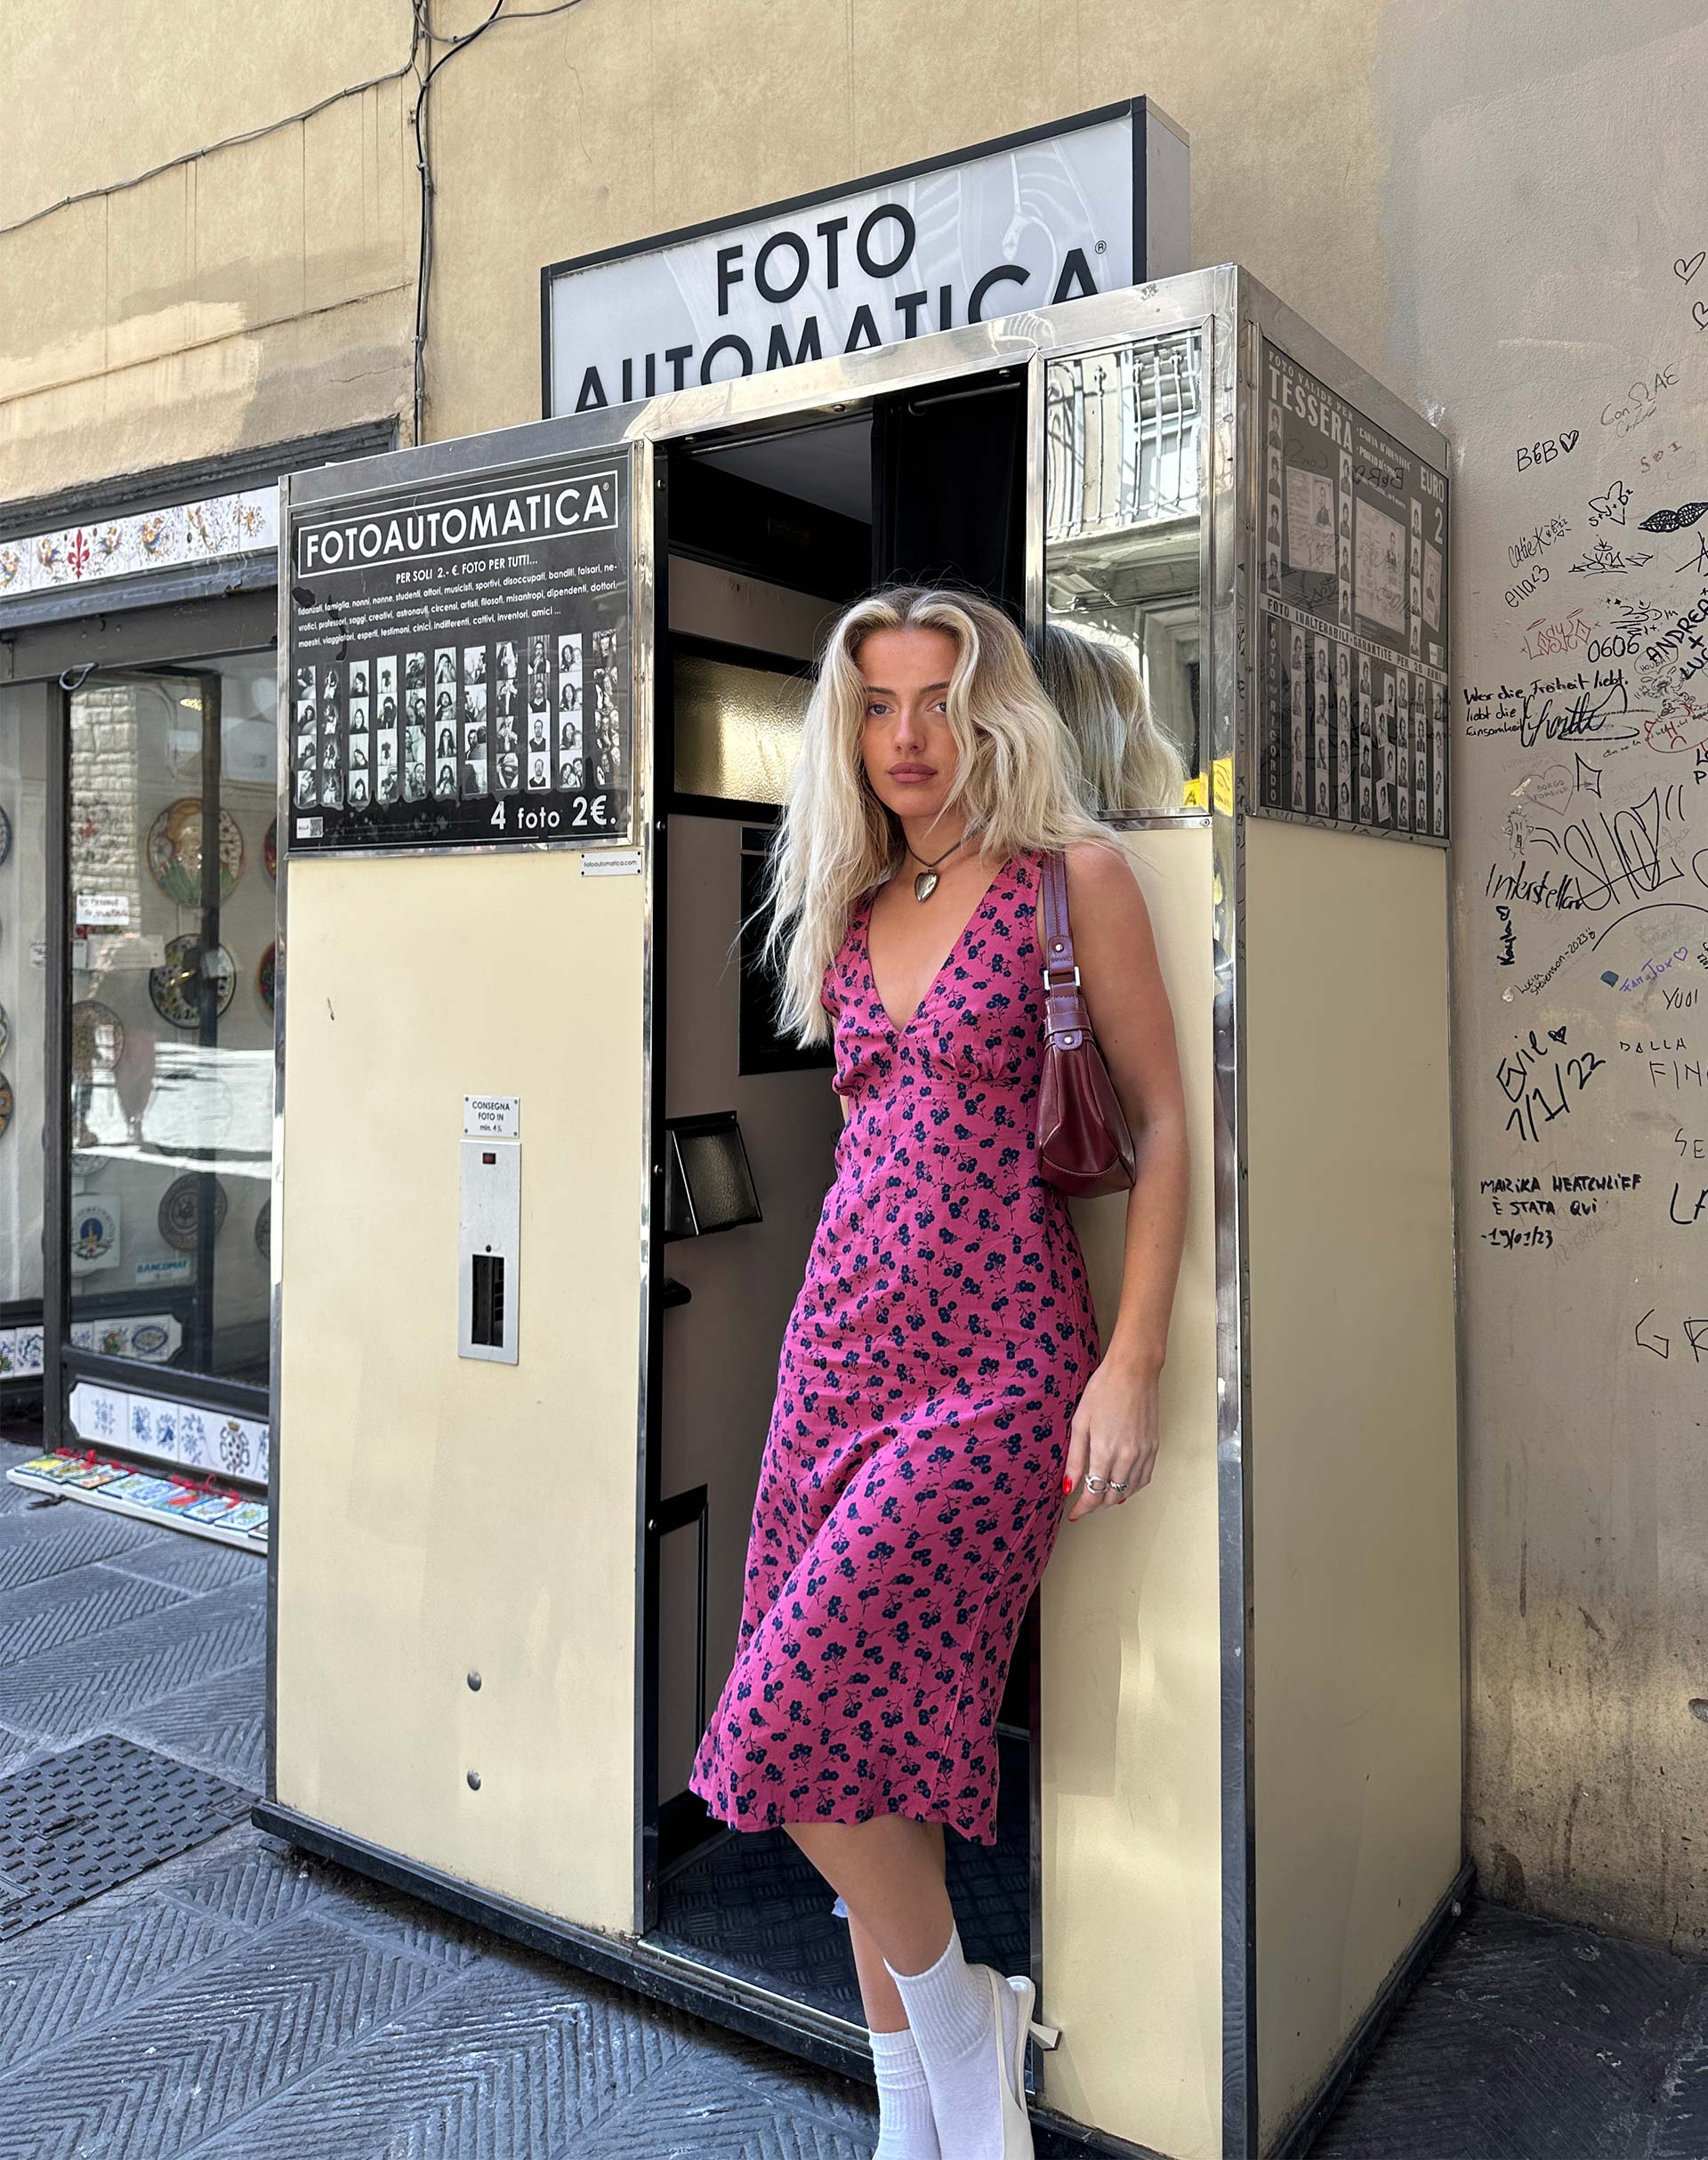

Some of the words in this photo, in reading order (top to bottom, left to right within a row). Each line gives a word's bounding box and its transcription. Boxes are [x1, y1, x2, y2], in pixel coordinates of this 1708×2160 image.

[717, 204, 915, 316] FOTO
[1269, 364, 1352, 453] TESSERA
[1420, 466, 1444, 504] EURO
[1434, 506, 1444, 544] 2
[396, 572, 411, 584] PER
[413, 568, 432, 582] SOLI
[462, 560, 486, 575] FOTO
[488, 558, 505, 570] PER
[604, 564, 617, 573] ne-
[531, 607, 552, 618] amici
[1268, 598, 1289, 617] FOTO
[1295, 609, 1349, 643] INALTERABILI
[1397, 654, 1409, 669] PER
[1414, 661, 1422, 673] 20
[1498, 685, 1524, 699] die
[1495, 703, 1517, 719] die
[490, 801, 505, 830] 4
[517, 806, 560, 829] foto
[1619, 1037, 1687, 1053] DALLA
[1649, 1060, 1708, 1090] FIN
[472, 1100, 510, 1110] CONSEGNA
[478, 1112, 495, 1121] FOTO
[496, 1113, 504, 1121] IN
[1510, 1200, 1556, 1216] STATA
